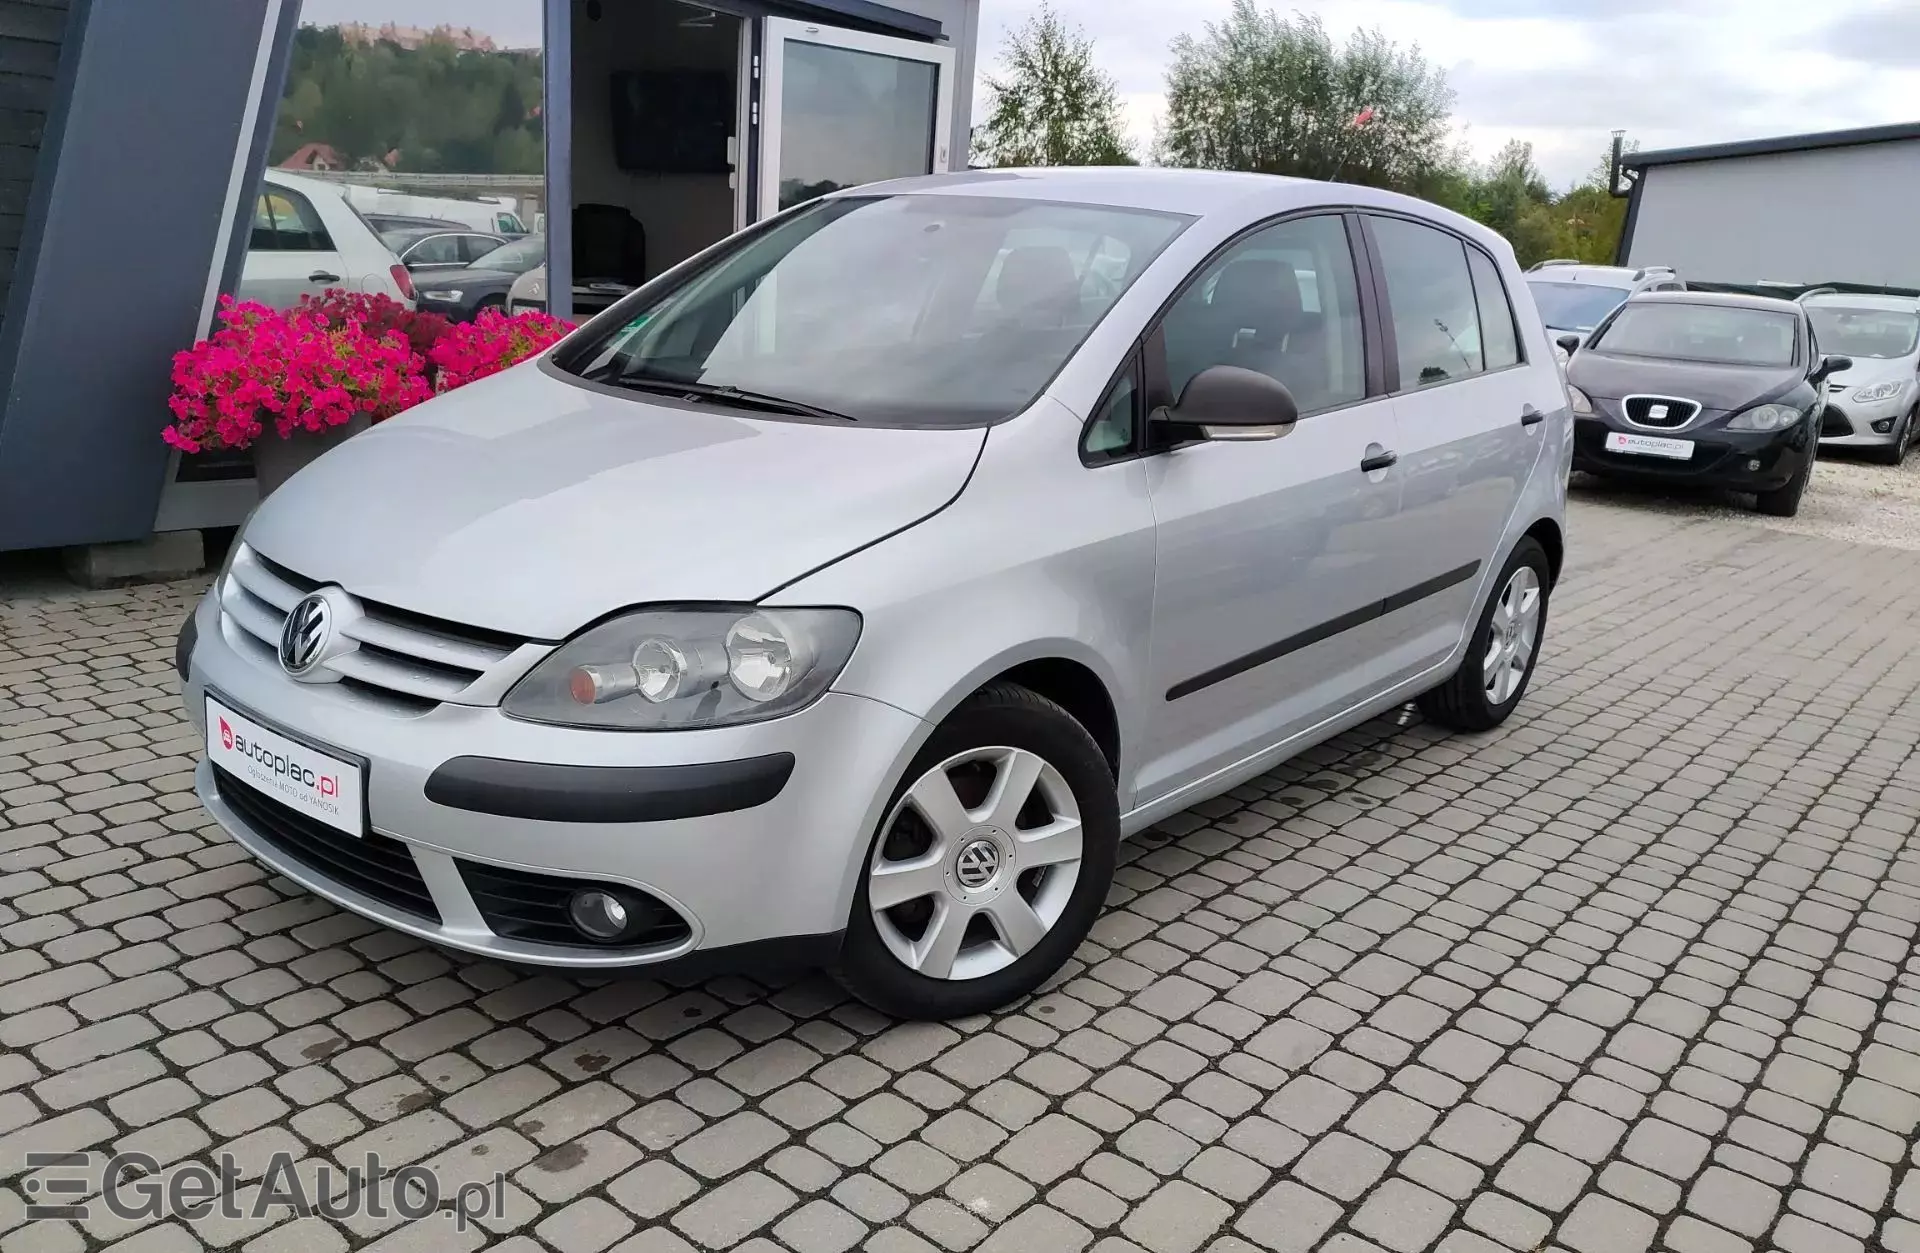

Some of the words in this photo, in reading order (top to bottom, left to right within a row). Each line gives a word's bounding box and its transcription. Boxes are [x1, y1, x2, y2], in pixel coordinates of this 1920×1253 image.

[235, 734, 339, 798] autoplac.pl
[279, 780, 298, 798] MOTO
[308, 796, 339, 815] YANOSIK
